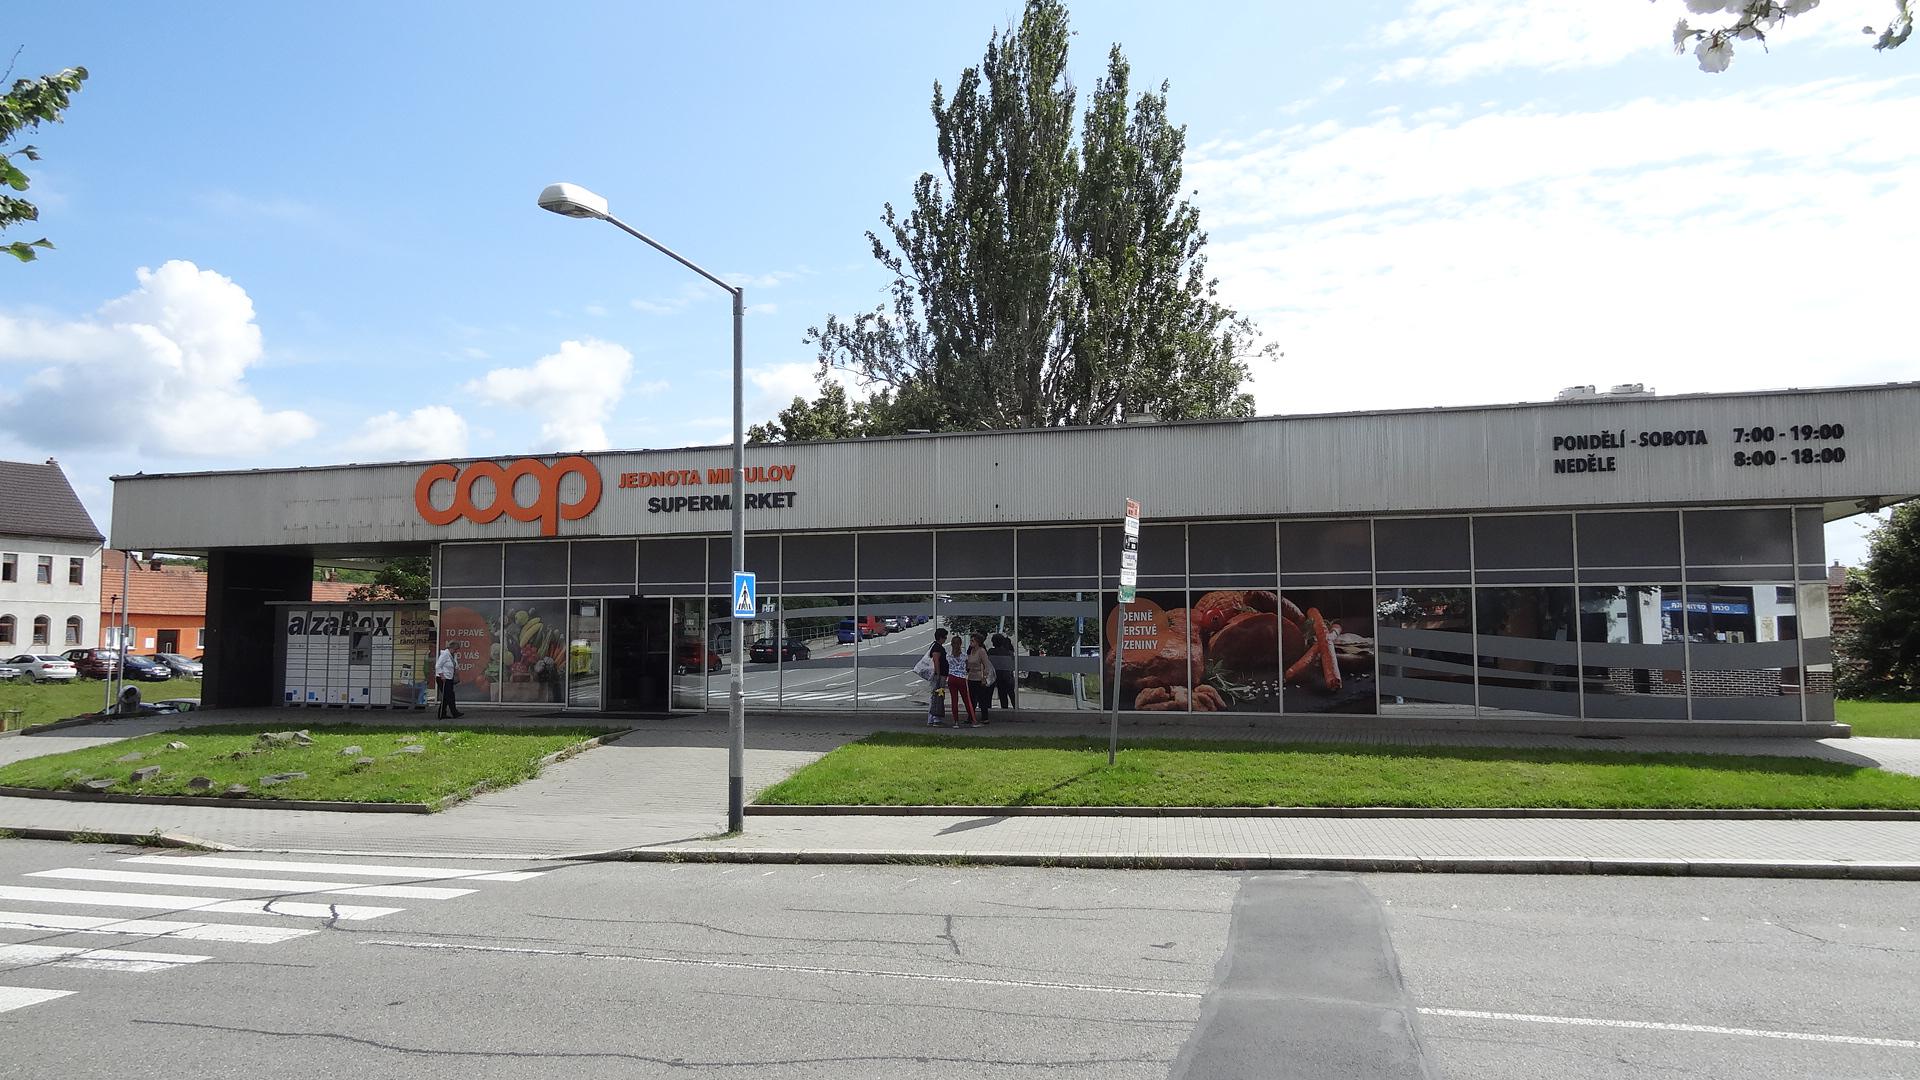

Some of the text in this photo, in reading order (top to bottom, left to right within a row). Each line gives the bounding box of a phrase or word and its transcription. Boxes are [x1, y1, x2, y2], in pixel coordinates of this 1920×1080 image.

[1553, 430, 1625, 450] PONDĚLÍ
[1639, 430, 1708, 447] SOBOTA
[1733, 426, 1775, 443] 7:00
[1790, 423, 1845, 441] 19:00
[1553, 454, 1616, 474] NEDĚLE
[1734, 450, 1776, 467] 8:00
[1791, 447, 1846, 464] 18:00
[618, 469, 702, 489] JEDNOTA
[415, 456, 603, 537] coop
[648, 492, 797, 514] SUPERMRKET
[288, 611, 392, 636] alzaBox
[1124, 624, 1158, 636] ERSTVÉ
[1122, 640, 1158, 650] ZENINY
